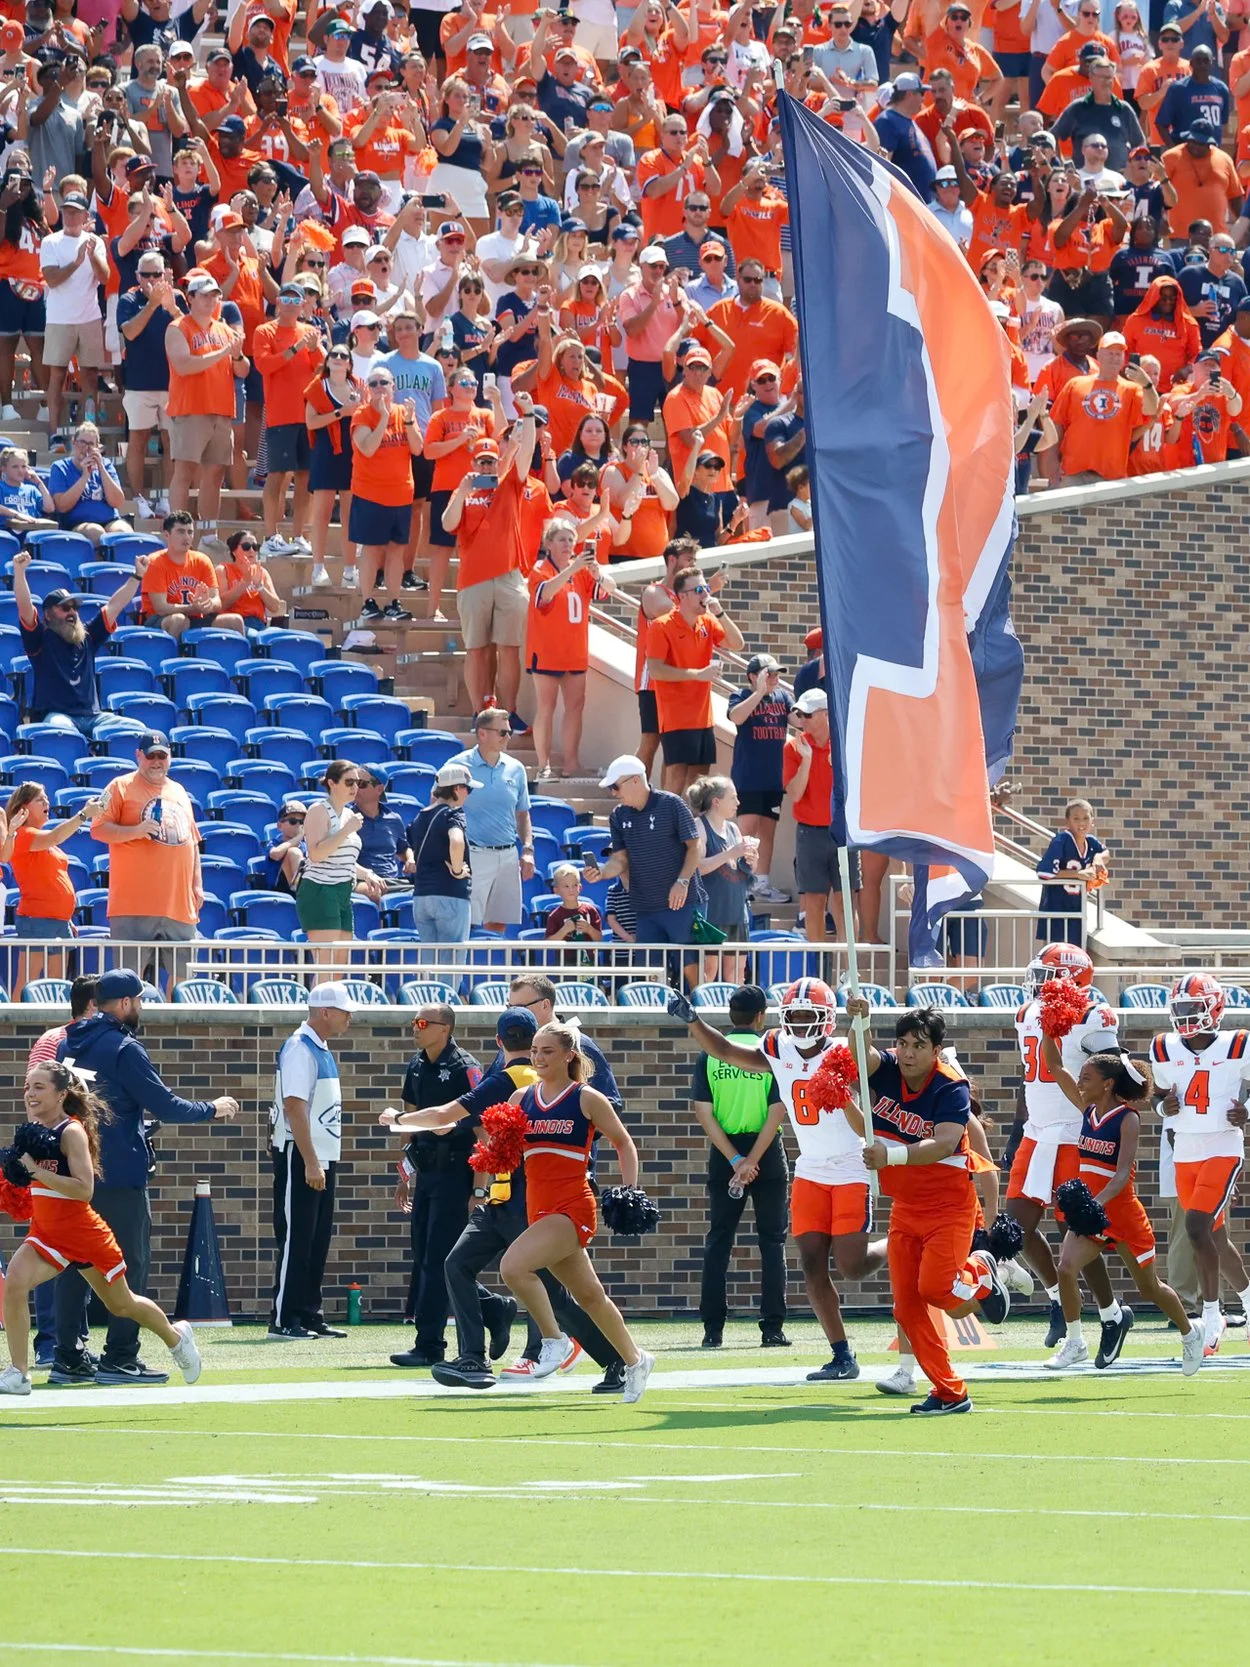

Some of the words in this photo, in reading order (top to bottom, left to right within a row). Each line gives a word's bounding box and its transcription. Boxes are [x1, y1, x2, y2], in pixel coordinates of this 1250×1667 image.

[396, 373, 431, 392] ULAN
[1143, 422, 1163, 453] 14
[30, 982, 72, 1003] DUK
[178, 982, 232, 1003] DUKE
[256, 982, 309, 1003] DUKE
[348, 982, 382, 1003] UKE
[405, 983, 458, 1005] DUKE
[479, 983, 511, 1005] DUK
[697, 986, 736, 1006] DUK
[914, 986, 963, 1007] DUKE
[1184, 1069, 1211, 1115] 4
[525, 1119, 574, 1135] LINOIS
